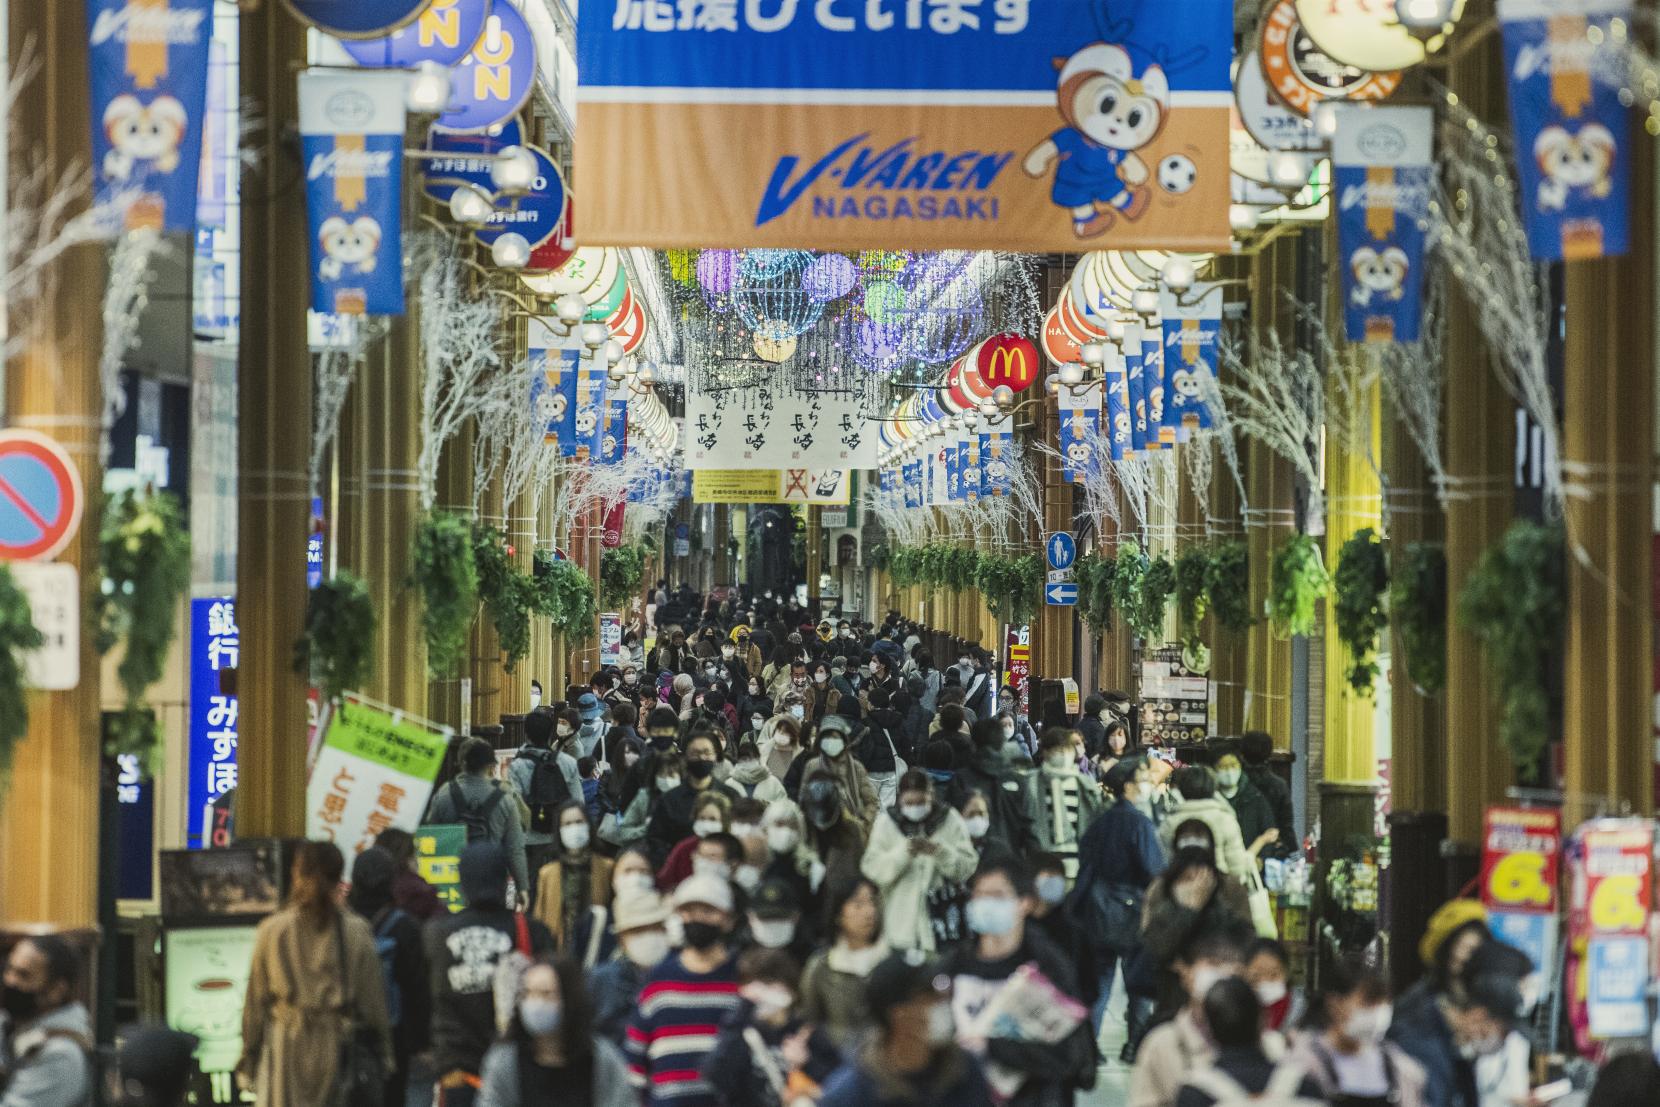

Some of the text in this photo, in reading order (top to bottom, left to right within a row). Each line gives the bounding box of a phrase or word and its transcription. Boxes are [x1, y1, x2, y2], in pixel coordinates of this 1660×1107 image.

[811, 196, 1000, 220] NAGASAKI
[1048, 327, 1066, 336] HA
[694, 413, 717, 451] 長崎
[742, 413, 765, 451] 長崎
[790, 413, 813, 451] 長崎
[838, 413, 861, 451] 長崎
